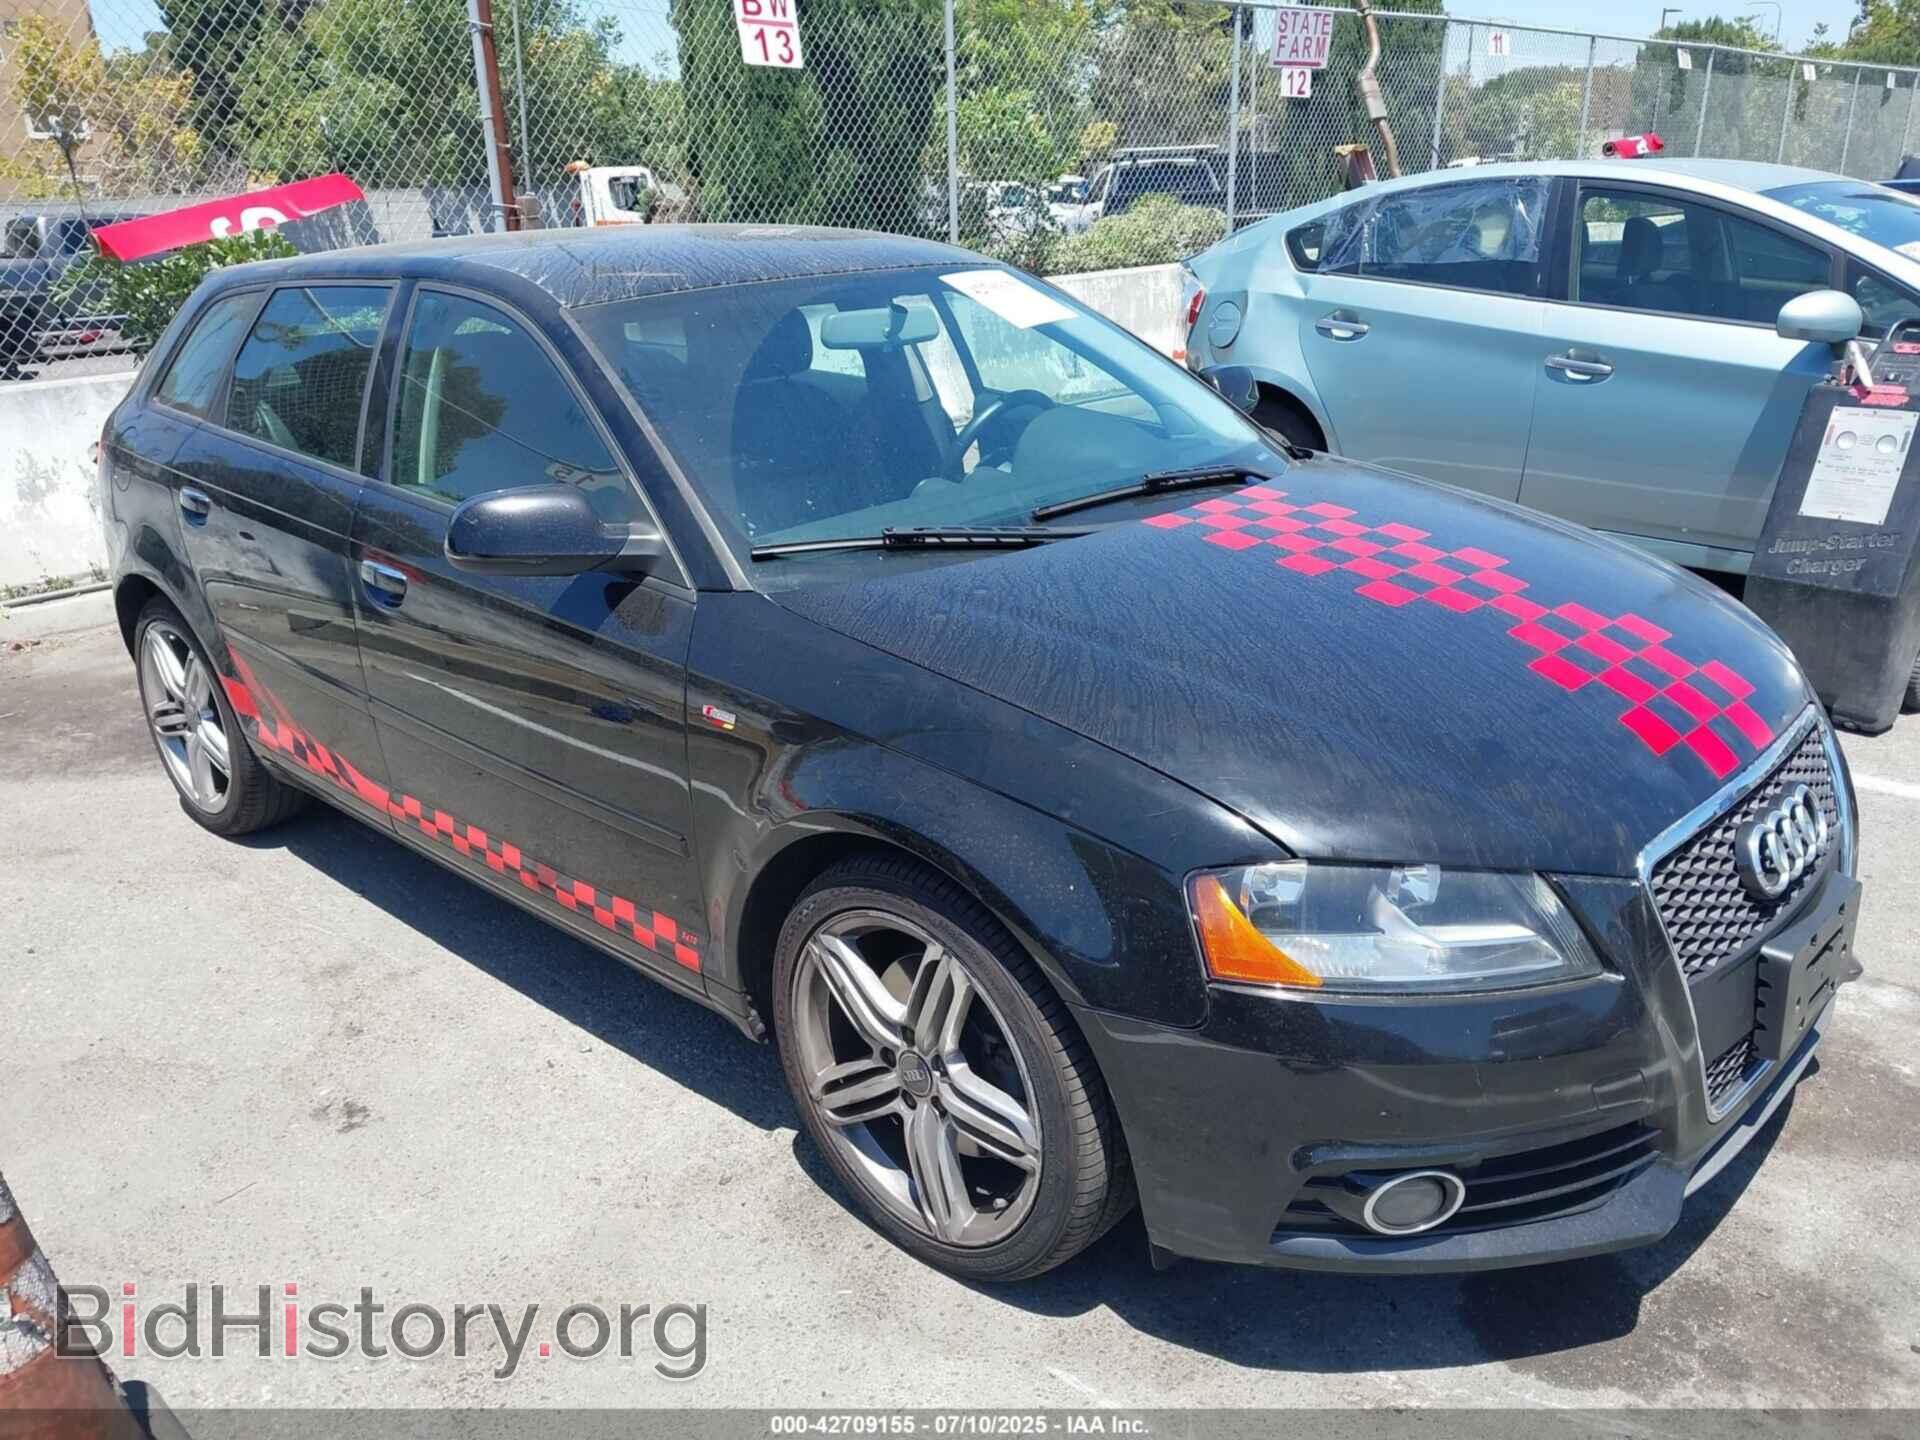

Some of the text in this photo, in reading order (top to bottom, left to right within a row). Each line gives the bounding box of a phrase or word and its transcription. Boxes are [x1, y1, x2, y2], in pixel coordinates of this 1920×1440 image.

[1278, 11, 1332, 36] STATE
[754, 28, 794, 64] 13
[1276, 35, 1327, 59] FARM
[1492, 33, 1503, 54] 11
[1287, 70, 1307, 95] 12
[1768, 532, 1900, 555] Jump-Starter
[1786, 557, 1867, 575] Charger
